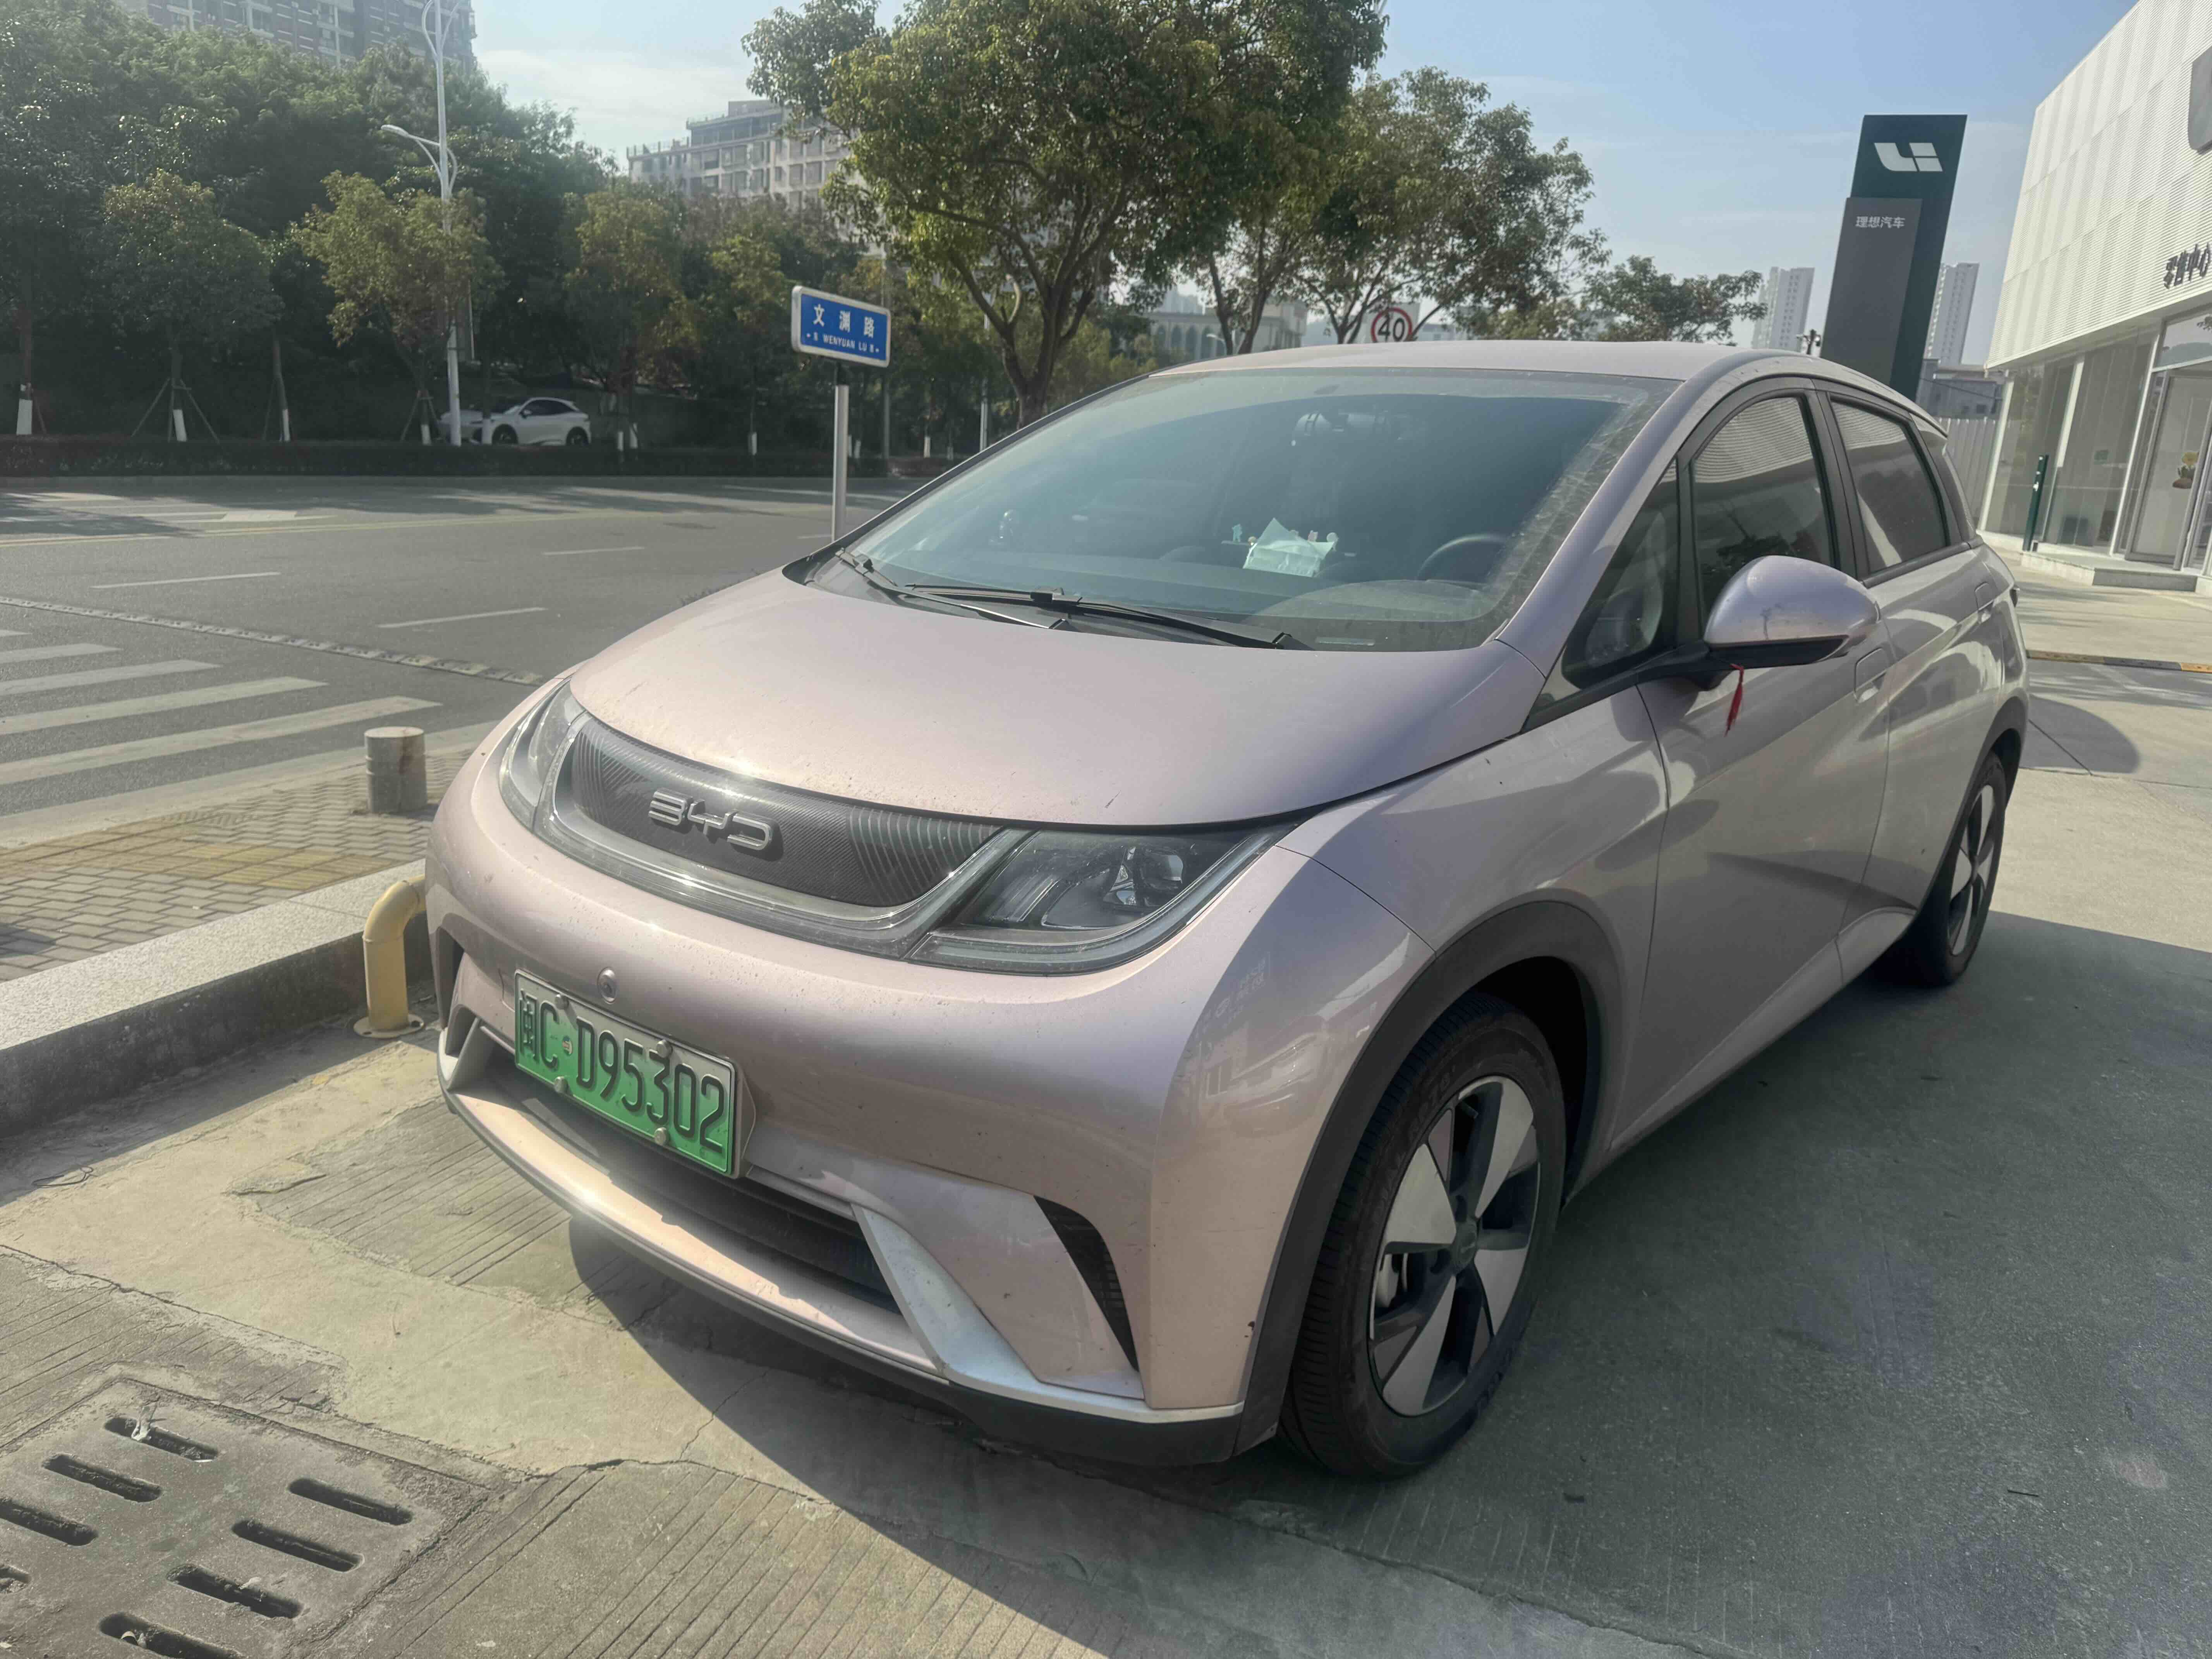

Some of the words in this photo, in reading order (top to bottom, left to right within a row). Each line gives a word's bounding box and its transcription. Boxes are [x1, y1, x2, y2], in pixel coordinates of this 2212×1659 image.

[1855, 216, 1906, 228] 理想汽车
[1378, 317, 1405, 342] 40
[823, 334, 855, 349] WENYUAN
[648, 788, 773, 851] BYD
